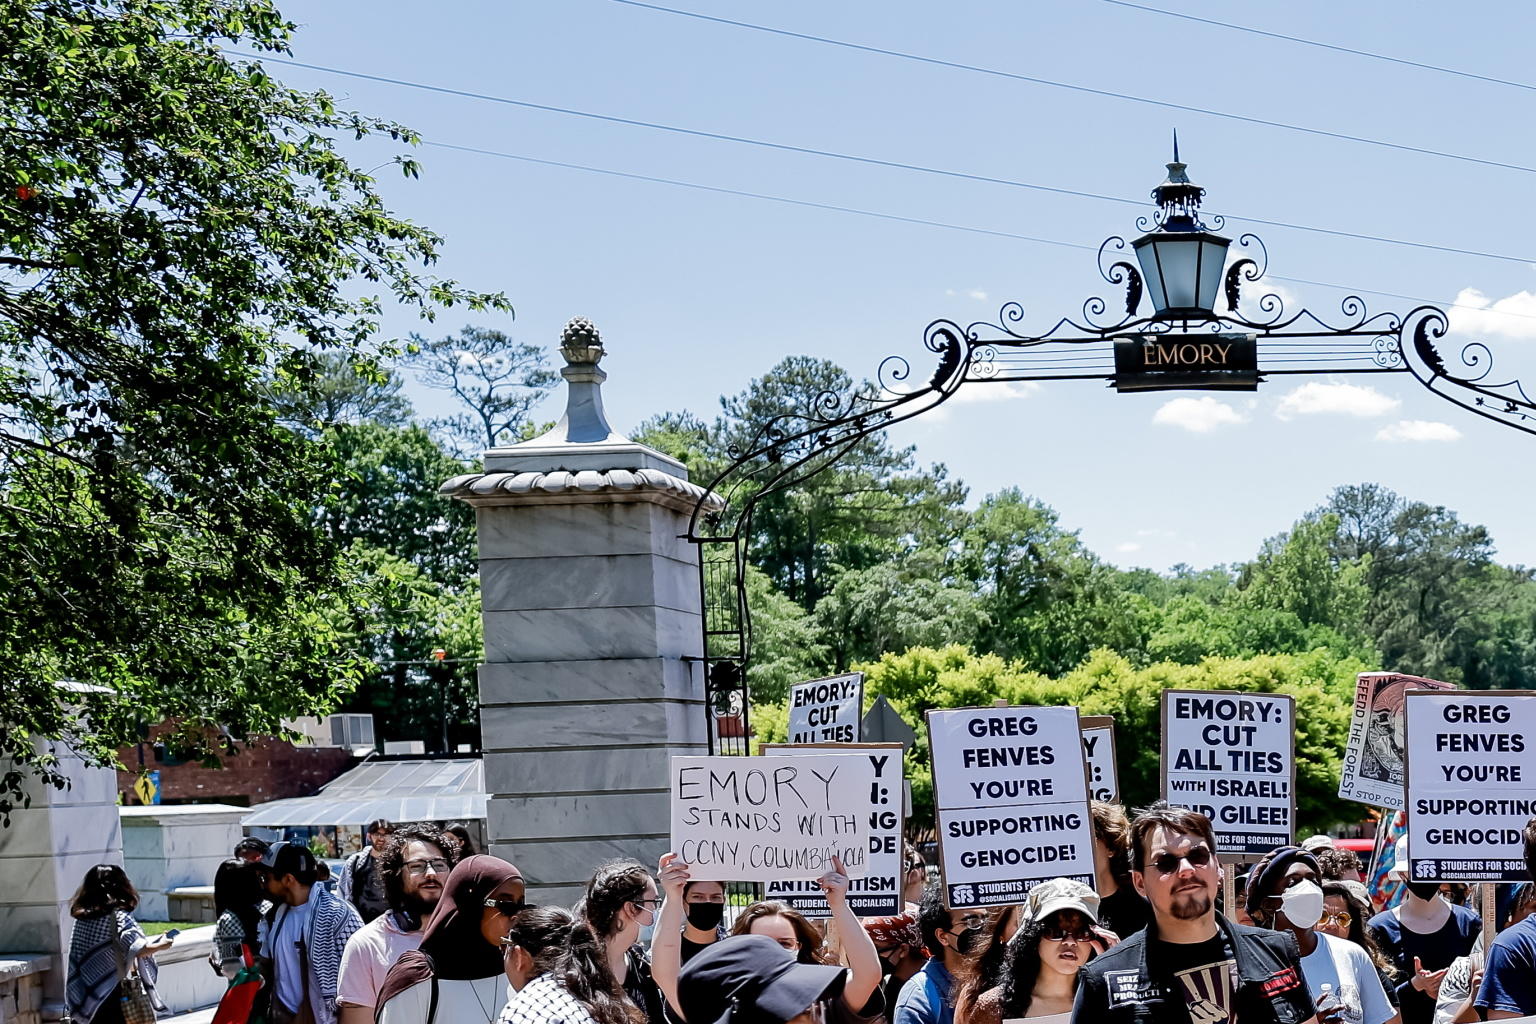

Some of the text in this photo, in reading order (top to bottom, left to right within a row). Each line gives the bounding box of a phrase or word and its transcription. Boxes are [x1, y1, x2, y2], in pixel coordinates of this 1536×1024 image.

[1143, 343, 1233, 366] EMORY
[794, 681, 855, 707] EMORY:
[808, 705, 839, 727] CUT
[1175, 698, 1282, 723] EMORY:
[1442, 704, 1511, 724] GREG
[821, 724, 854, 743] TIES
[967, 716, 1039, 738] GREG
[1202, 724, 1257, 747] CUT
[1341, 676, 1370, 796] EFEND THE FOREST
[1436, 733, 1525, 753] FENVES
[962, 745, 1056, 769] FENVES
[1174, 748, 1284, 774] ALL TIES
[1440, 765, 1522, 782] YOU'RE
[679, 764, 840, 811] EMORY
[969, 778, 1055, 800] YOU'RE
[1171, 779, 1288, 799] WITH ISRAEL!
[1355, 790, 1382, 802] STOP
[681, 806, 781, 834] STANDS
[797, 813, 858, 837] WITH
[948, 813, 1082, 838] SUPPORTING
[1219, 805, 1288, 826] GILEE!
[1231, 835, 1247, 844] FOR
[1247, 835, 1286, 846] SOCIALISM
[1425, 829, 1525, 845] GENOCID
[681, 838, 745, 871] CCNY,
[749, 843, 834, 871] COLUMBIA
[960, 844, 1077, 869] GENOCIDE!
[1415, 864, 1437, 878] SFS
[1440, 861, 1483, 871] STUDENTS
[1485, 861, 1502, 871] FOR
[952, 885, 975, 905] SFS
[978, 881, 1023, 895] STUDENTS
[851, 898, 895, 908] SOCIALISM
